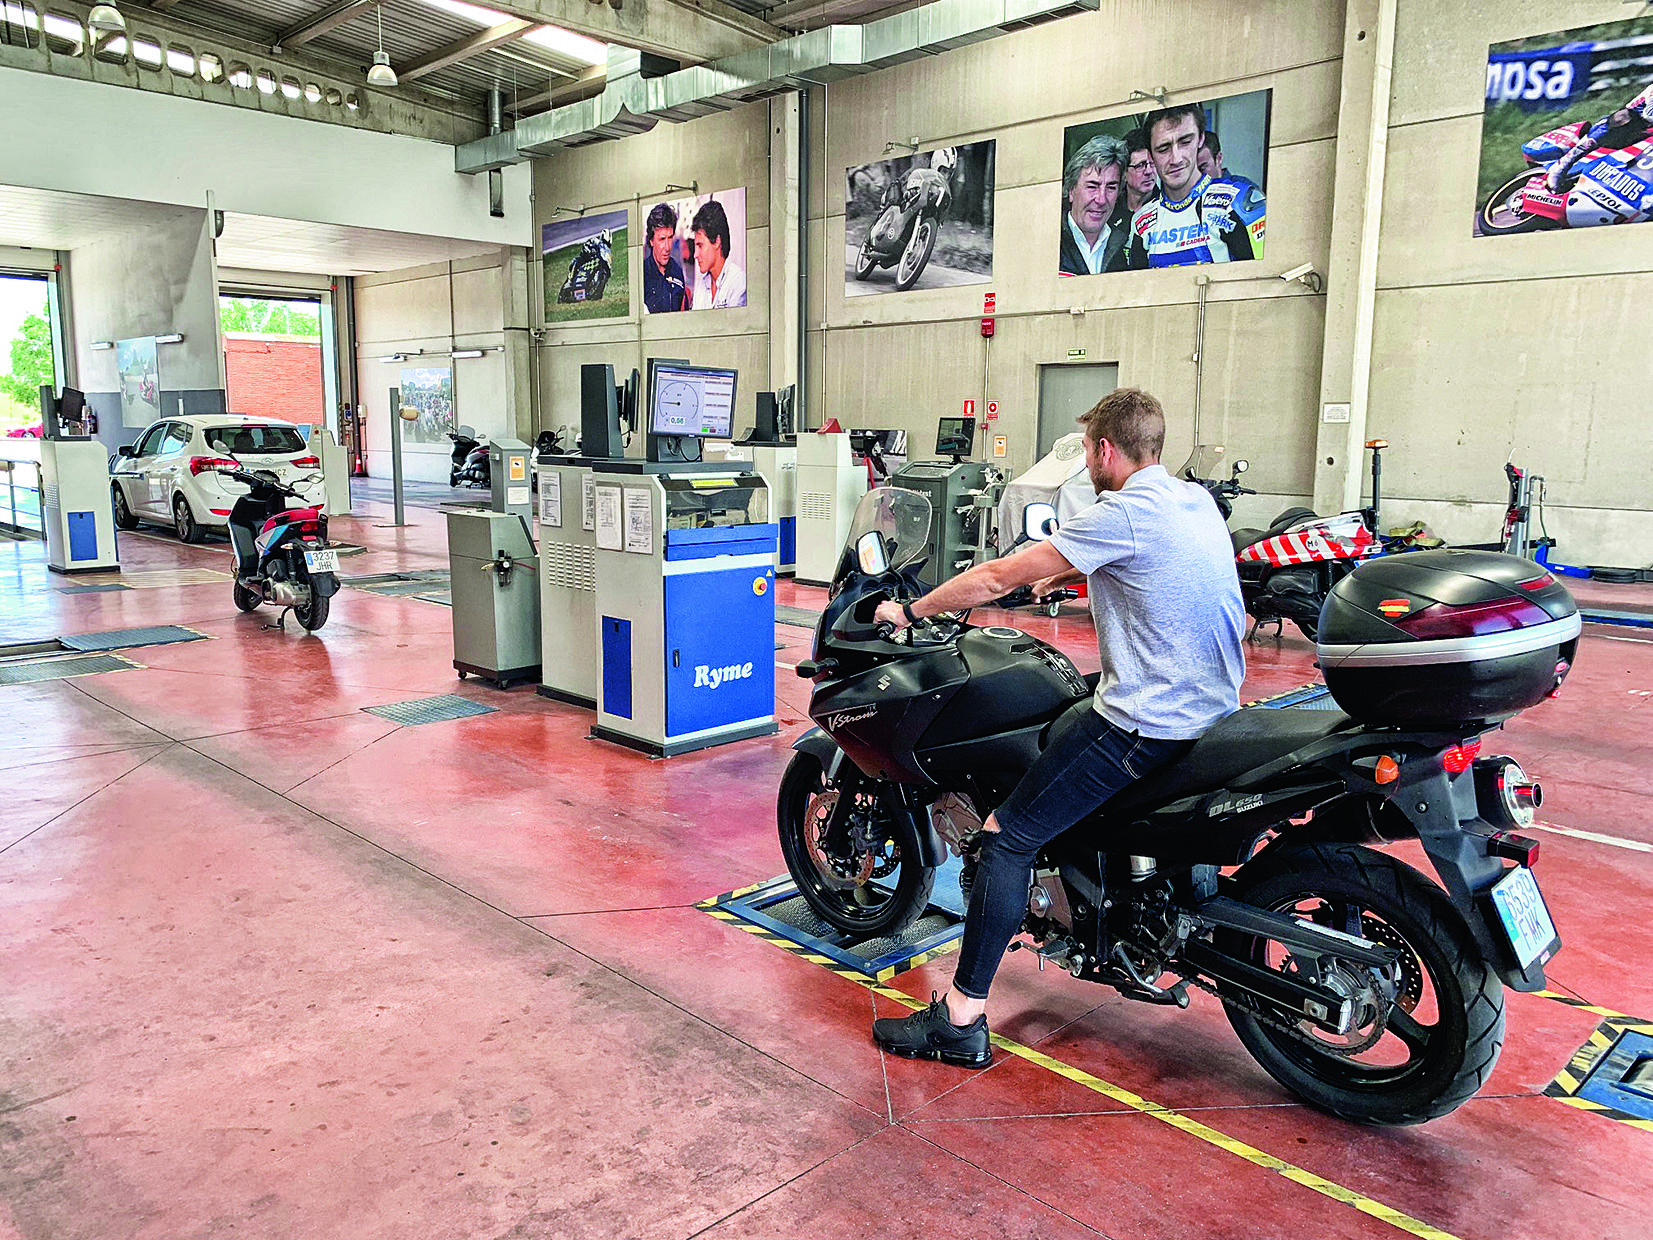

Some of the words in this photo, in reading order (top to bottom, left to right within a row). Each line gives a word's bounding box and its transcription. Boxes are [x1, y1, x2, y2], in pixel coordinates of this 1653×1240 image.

[1526, 193, 1563, 206] MICHELIN
[312, 551, 334, 562] 3237
[316, 561, 334, 572] JHR
[693, 661, 753, 689] Ryme
[1208, 801, 1235, 818] DL
[1235, 793, 1263, 808] 650
[1236, 800, 1264, 814] SUZUKI
[1503, 873, 1537, 922] 6539
